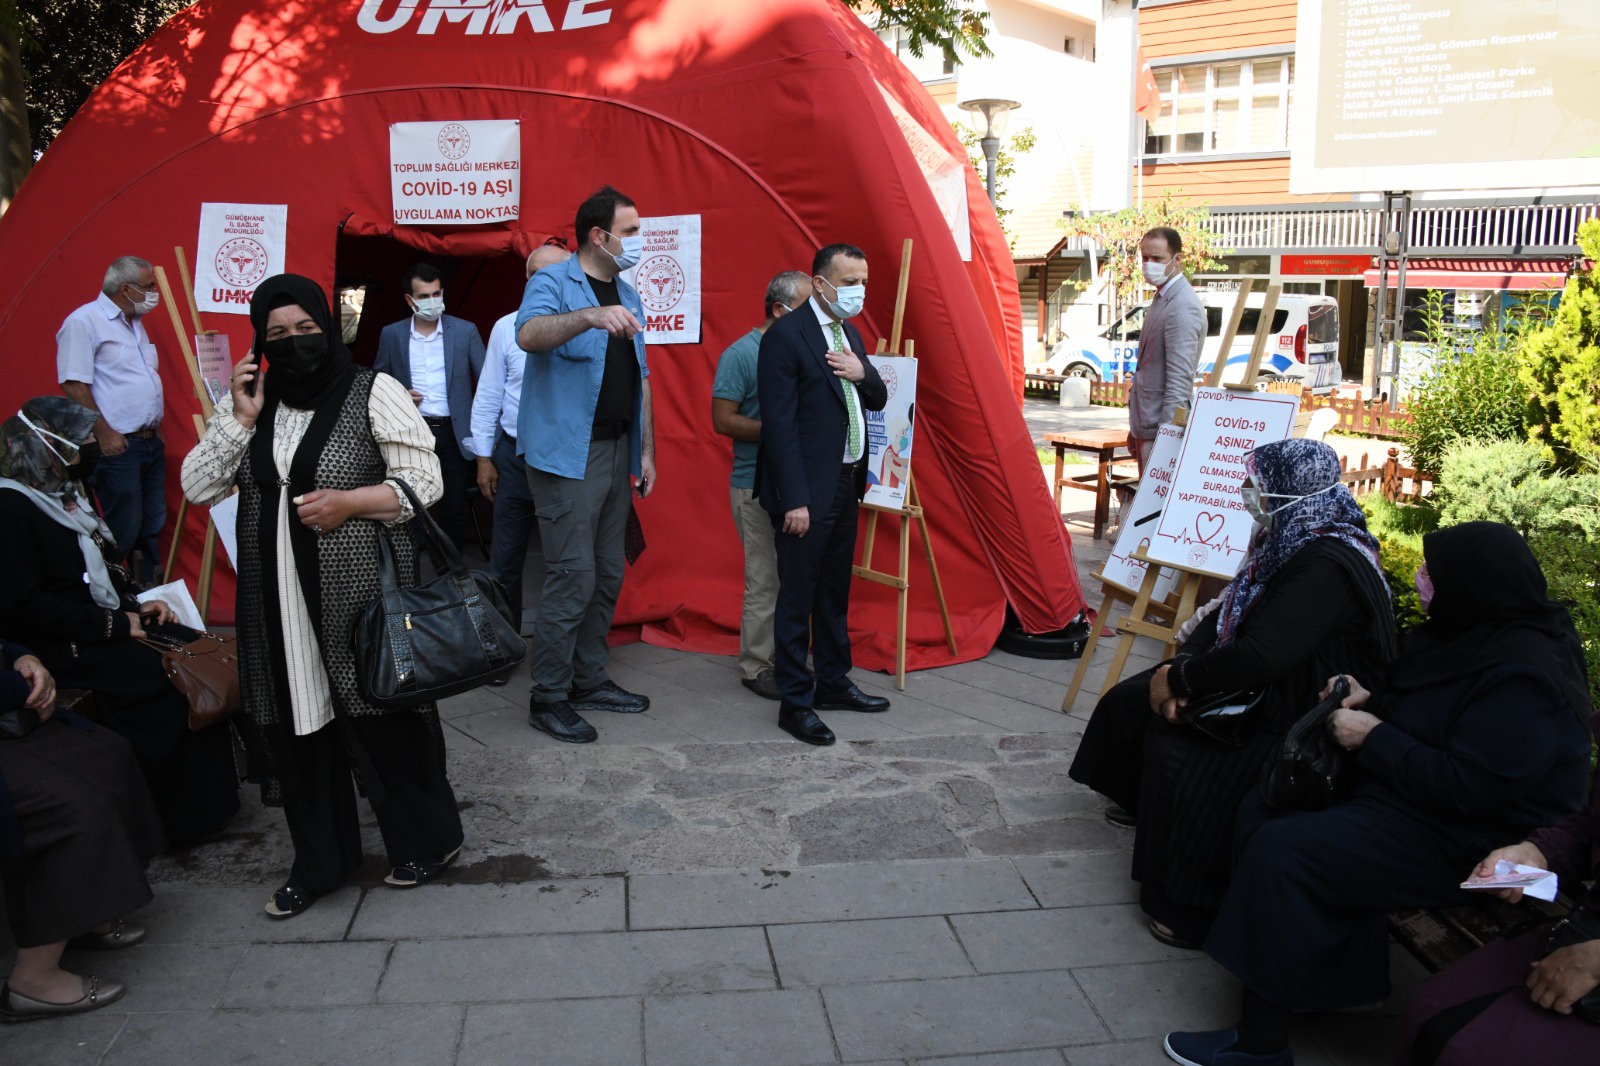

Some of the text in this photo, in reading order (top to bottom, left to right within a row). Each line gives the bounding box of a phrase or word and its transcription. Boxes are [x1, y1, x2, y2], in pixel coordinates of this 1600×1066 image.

[1399, 10, 1450, 21] Banyosu
[1380, 22, 1420, 33] Mutfak
[1346, 48, 1365, 58] WC
[1385, 43, 1436, 55] Banyoda
[1440, 39, 1489, 49] Gömme
[1491, 31, 1559, 45] Rezervuar
[1344, 70, 1377, 78] Saten
[1405, 66, 1419, 74] ve
[1422, 64, 1452, 73] Boya
[1344, 80, 1376, 89] Salon
[1395, 75, 1435, 85] Odalar
[1499, 66, 1537, 77] Parke
[1344, 90, 1376, 99] Antre
[1371, 97, 1424, 108] Zeminler
[1500, 87, 1554, 99] Seramik
[394, 159, 519, 172] TOPLUM SAĞLIĞI MERKEZİ
[402, 178, 513, 197] COVİD-19 AŞI
[225, 214, 265, 222] GÜMÜŞHANE
[395, 209, 462, 219] UYGULAMA
[642, 229, 679, 237] GÜMÜŞHANE
[642, 244, 679, 252] MÜDÜRLÜĞÜ
[212, 288, 256, 304] UMK
[646, 314, 685, 332] MKE
[1281, 336, 1292, 345] 112
[1215, 417, 1266, 432] COVİD-19
[1215, 435, 1255, 450] AŞINIZI
[1200, 465, 1249, 480] OLMAKSIZI
[1203, 482, 1240, 495] BURADA
